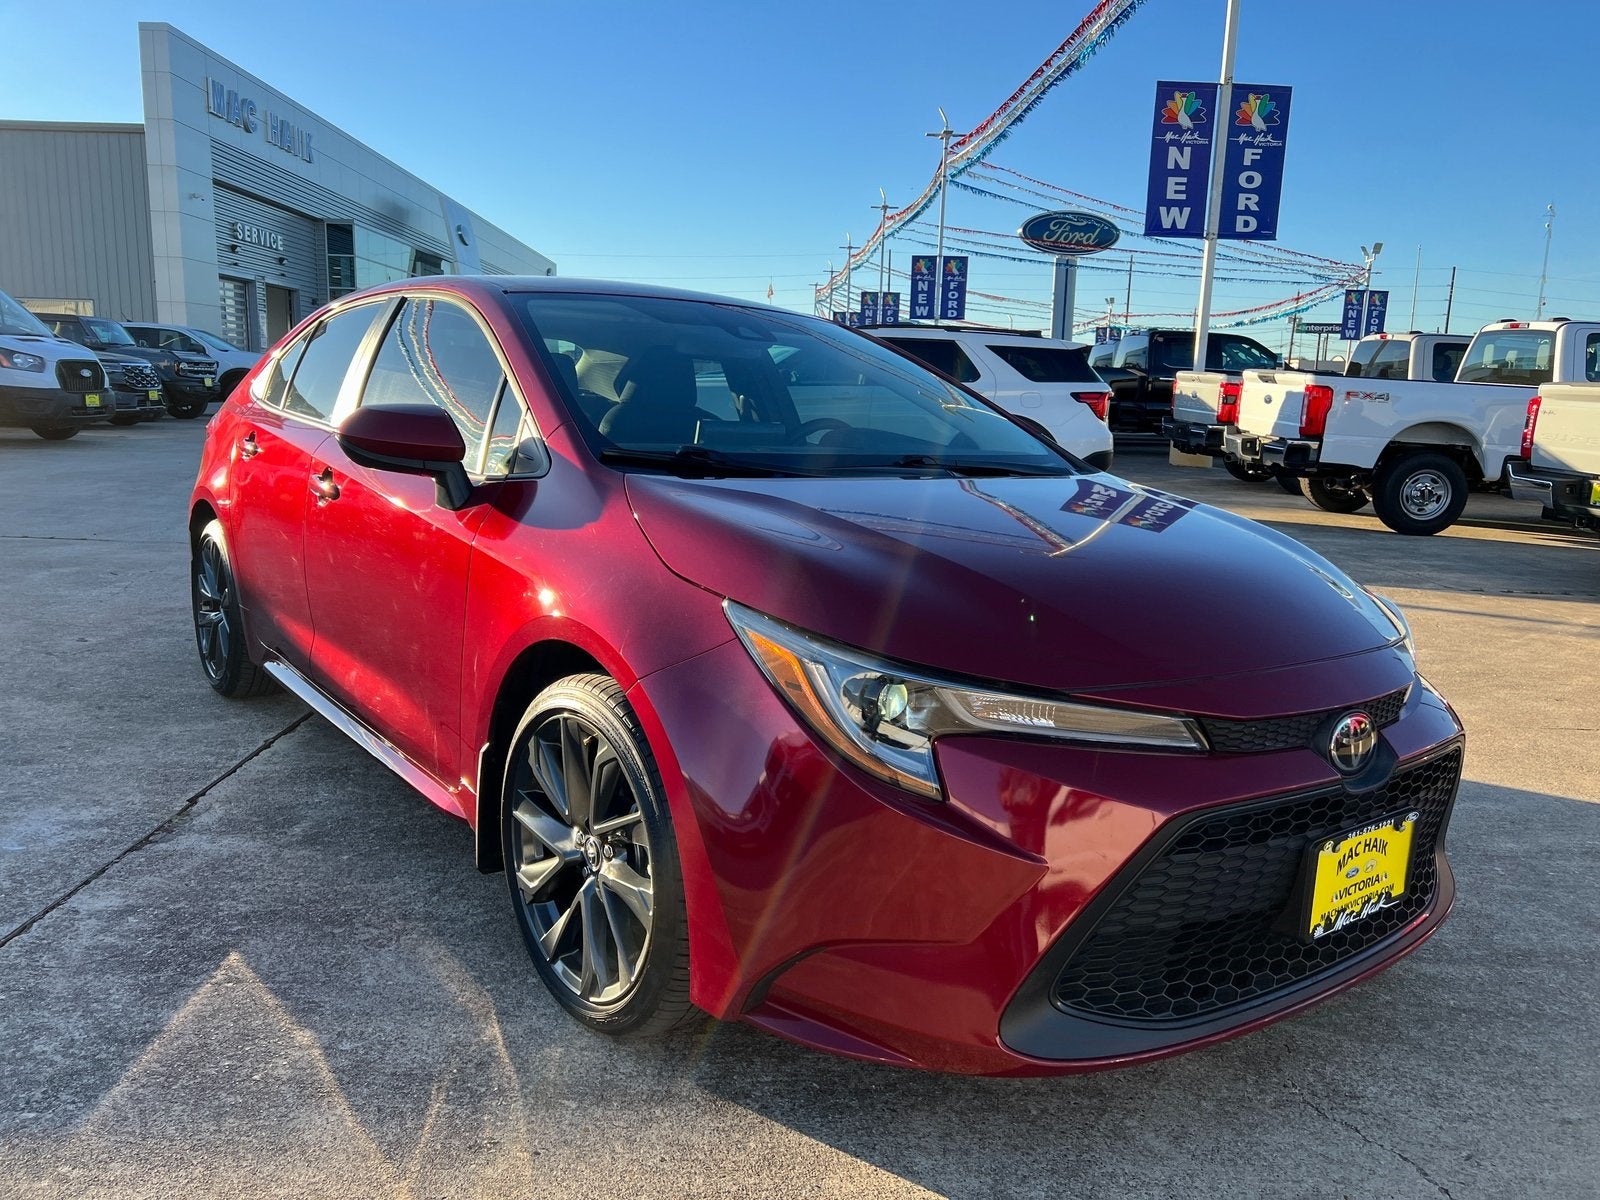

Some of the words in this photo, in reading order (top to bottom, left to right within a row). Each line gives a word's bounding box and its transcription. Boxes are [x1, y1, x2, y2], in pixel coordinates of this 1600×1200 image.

[206, 77, 257, 134] MAC
[266, 111, 314, 164] HAIK
[1159, 146, 1191, 230] NEW
[1235, 148, 1263, 233] FORD
[235, 222, 284, 251] SERVICE
[1043, 219, 1103, 245] Ford
[915, 280, 929, 317] NEW
[947, 281, 959, 318] FORD
[886, 310, 894, 325] FO
[1345, 309, 1357, 338] NEW
[1370, 310, 1379, 335] FOR
[1345, 391, 1390, 401] FX4
[1336, 841, 1361, 875] MAC
[1363, 837, 1388, 857] HAIK
[1338, 874, 1380, 900] VICTORIA
[1327, 911, 1360, 932] Mac
[1359, 895, 1395, 919] Haik
